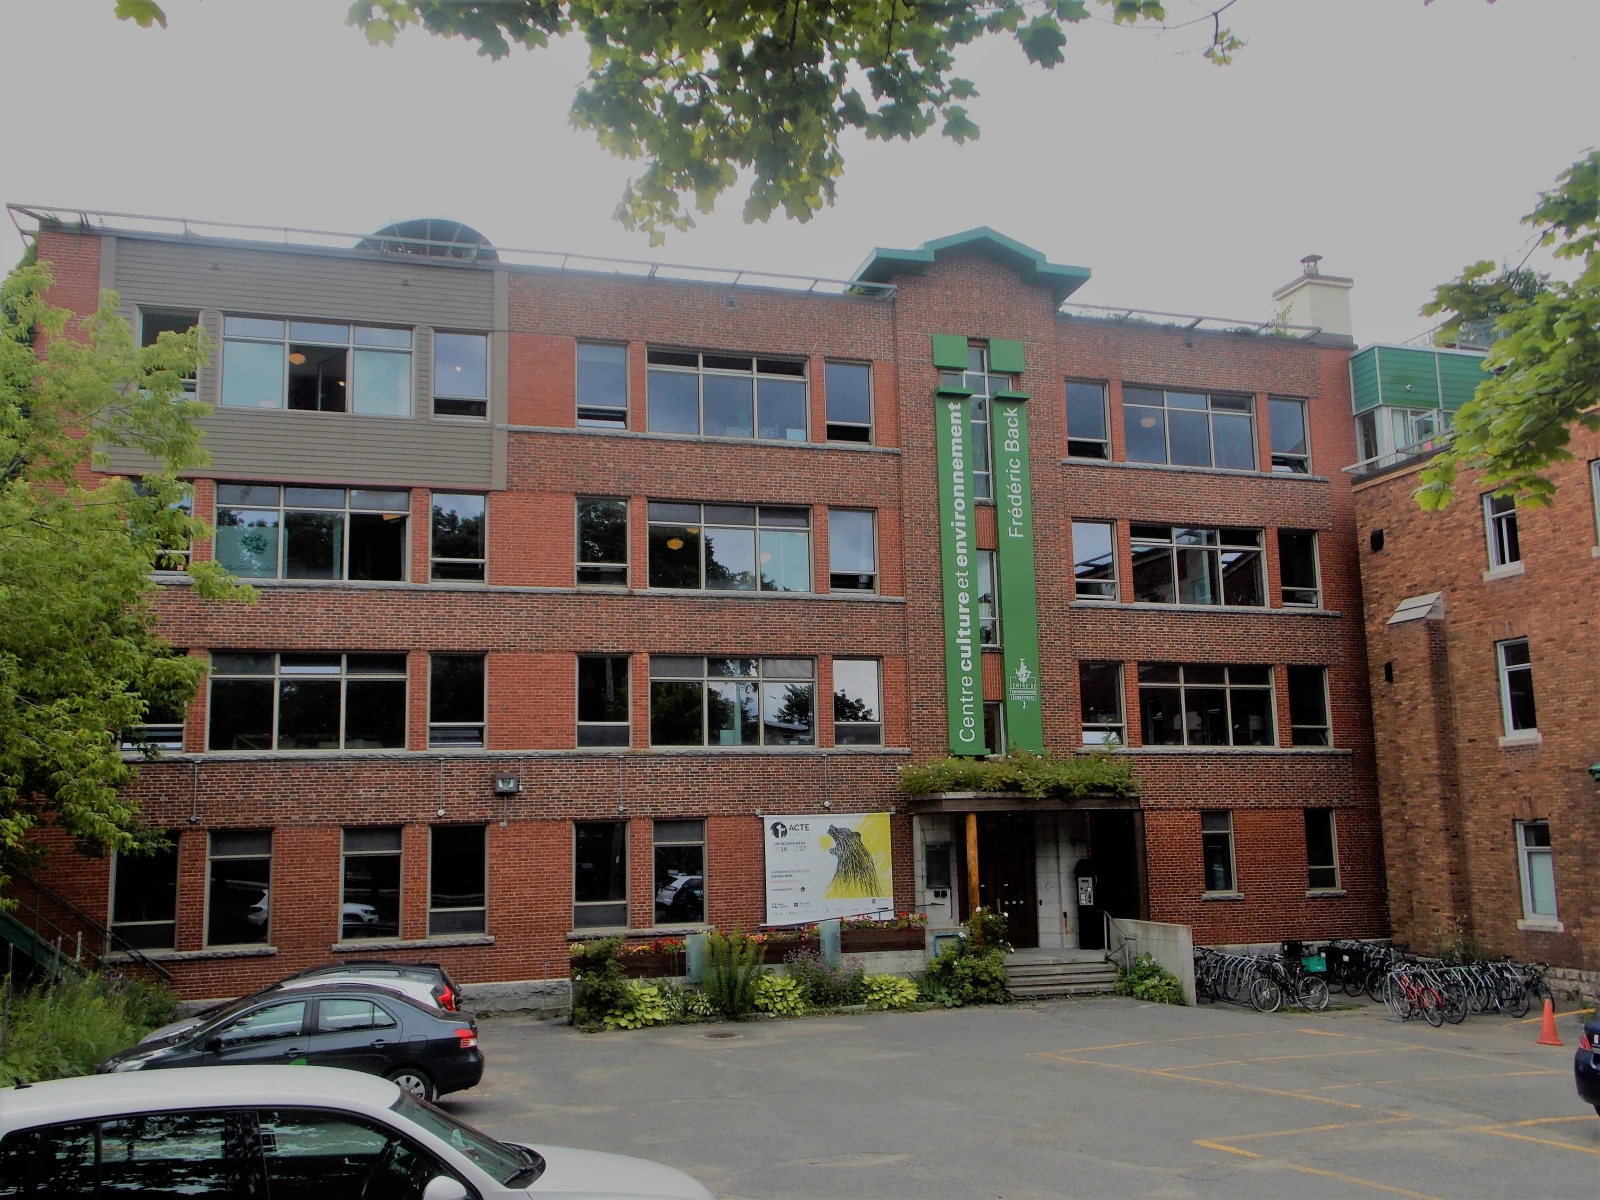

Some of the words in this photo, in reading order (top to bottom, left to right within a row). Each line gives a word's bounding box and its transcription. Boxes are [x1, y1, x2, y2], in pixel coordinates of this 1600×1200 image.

[1003, 406, 1020, 452] Back
[948, 402, 969, 567] environnement
[1006, 458, 1024, 538] Frédéric
[954, 570, 969, 589] et
[956, 591, 973, 672] culture
[959, 675, 976, 743] Centre
[788, 823, 810, 832] ACTE
